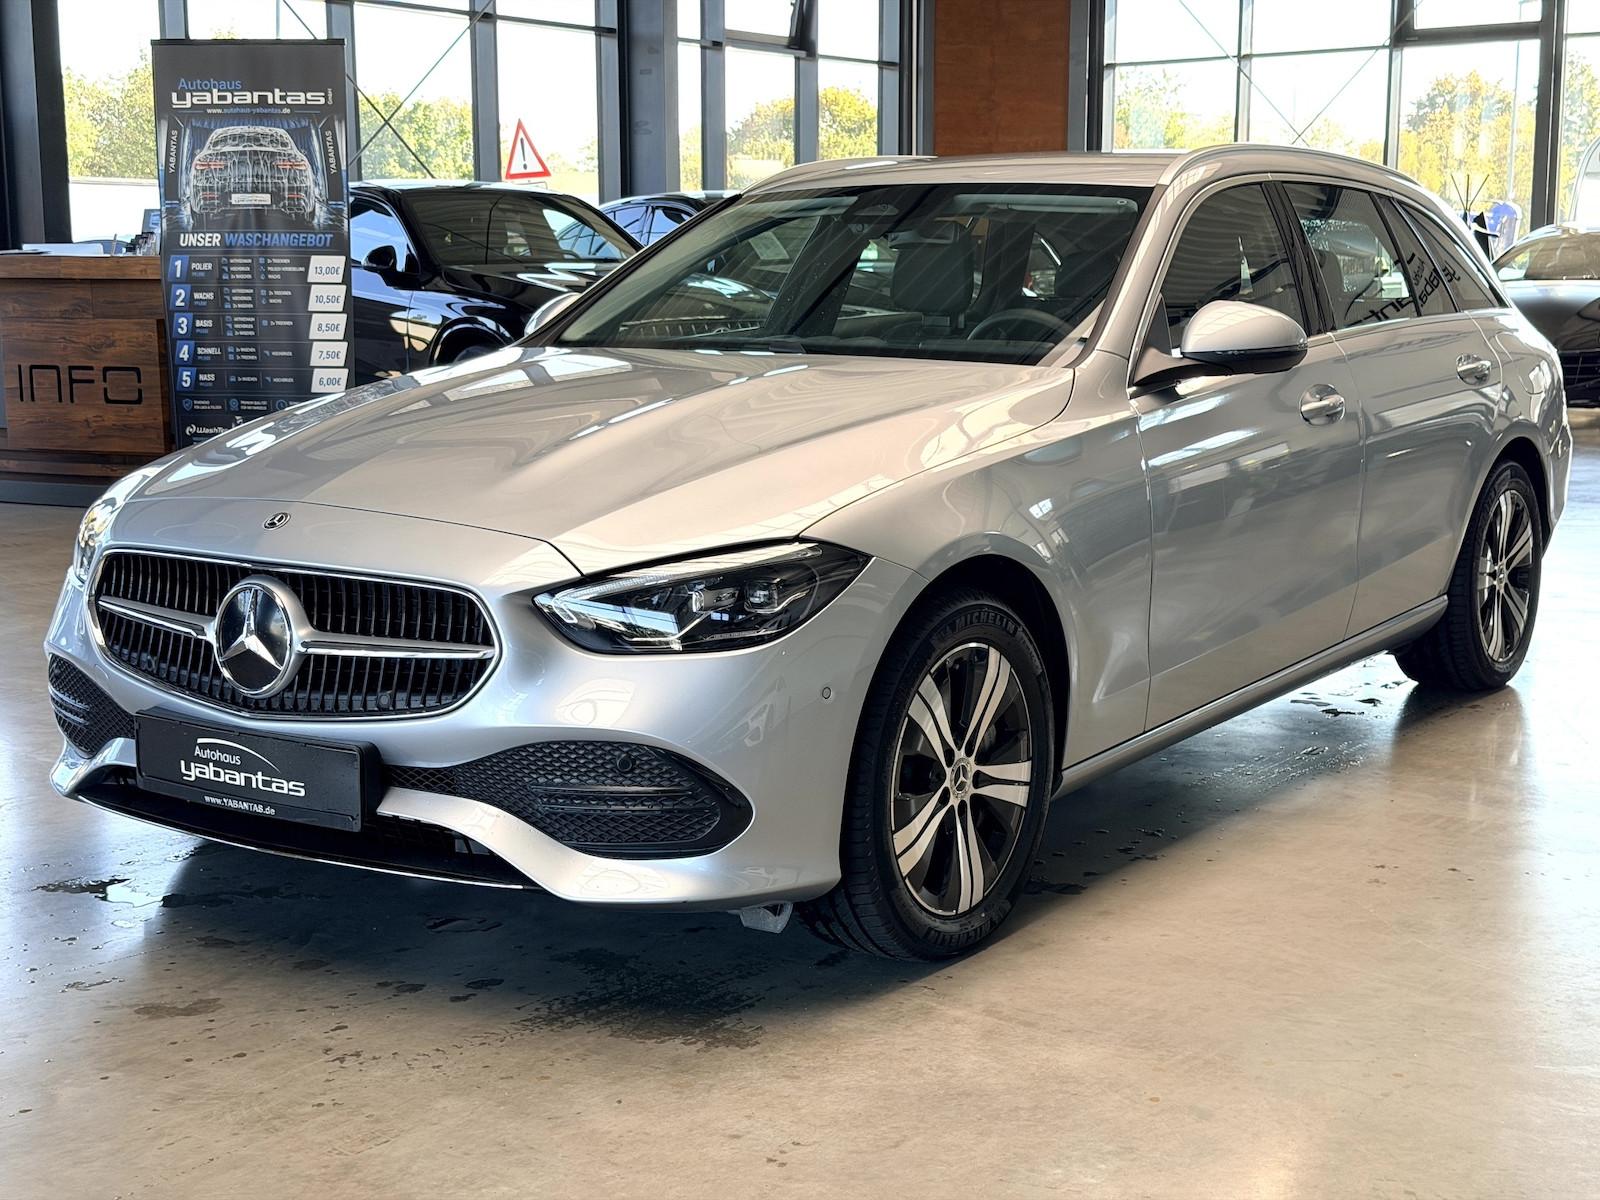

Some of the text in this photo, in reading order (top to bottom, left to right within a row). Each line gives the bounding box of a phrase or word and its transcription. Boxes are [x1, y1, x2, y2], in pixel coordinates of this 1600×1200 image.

[178, 78, 242, 90] Autohaus
[171, 88, 325, 109] yabantas
[168, 130, 178, 174] YABANTAS
[325, 130, 337, 175] YABANTAS
[179, 233, 333, 247] UNSER WASCHANGEBOT
[174, 260, 213, 278] 1 POLIER
[314, 266, 341, 276] 13,00€
[175, 289, 214, 306] 2 WACHS
[315, 295, 341, 304] 10,50€
[177, 317, 188, 334] 3
[195, 320, 213, 328] BASIS
[317, 323, 341, 333] 8,50€
[179, 344, 221, 361] 4 SCHNELL
[318, 351, 341, 360] 7,50€
[18, 364, 143, 404] INFO
[181, 371, 191, 387] 5
[199, 373, 216, 381] NASS
[318, 377, 342, 387] 6,00€
[954, 611, 1018, 636] MICHELIN
[194, 744, 242, 766] Autohaus
[180, 759, 306, 797] yabantas
[203, 794, 276, 816] www.YABANTAS.de
